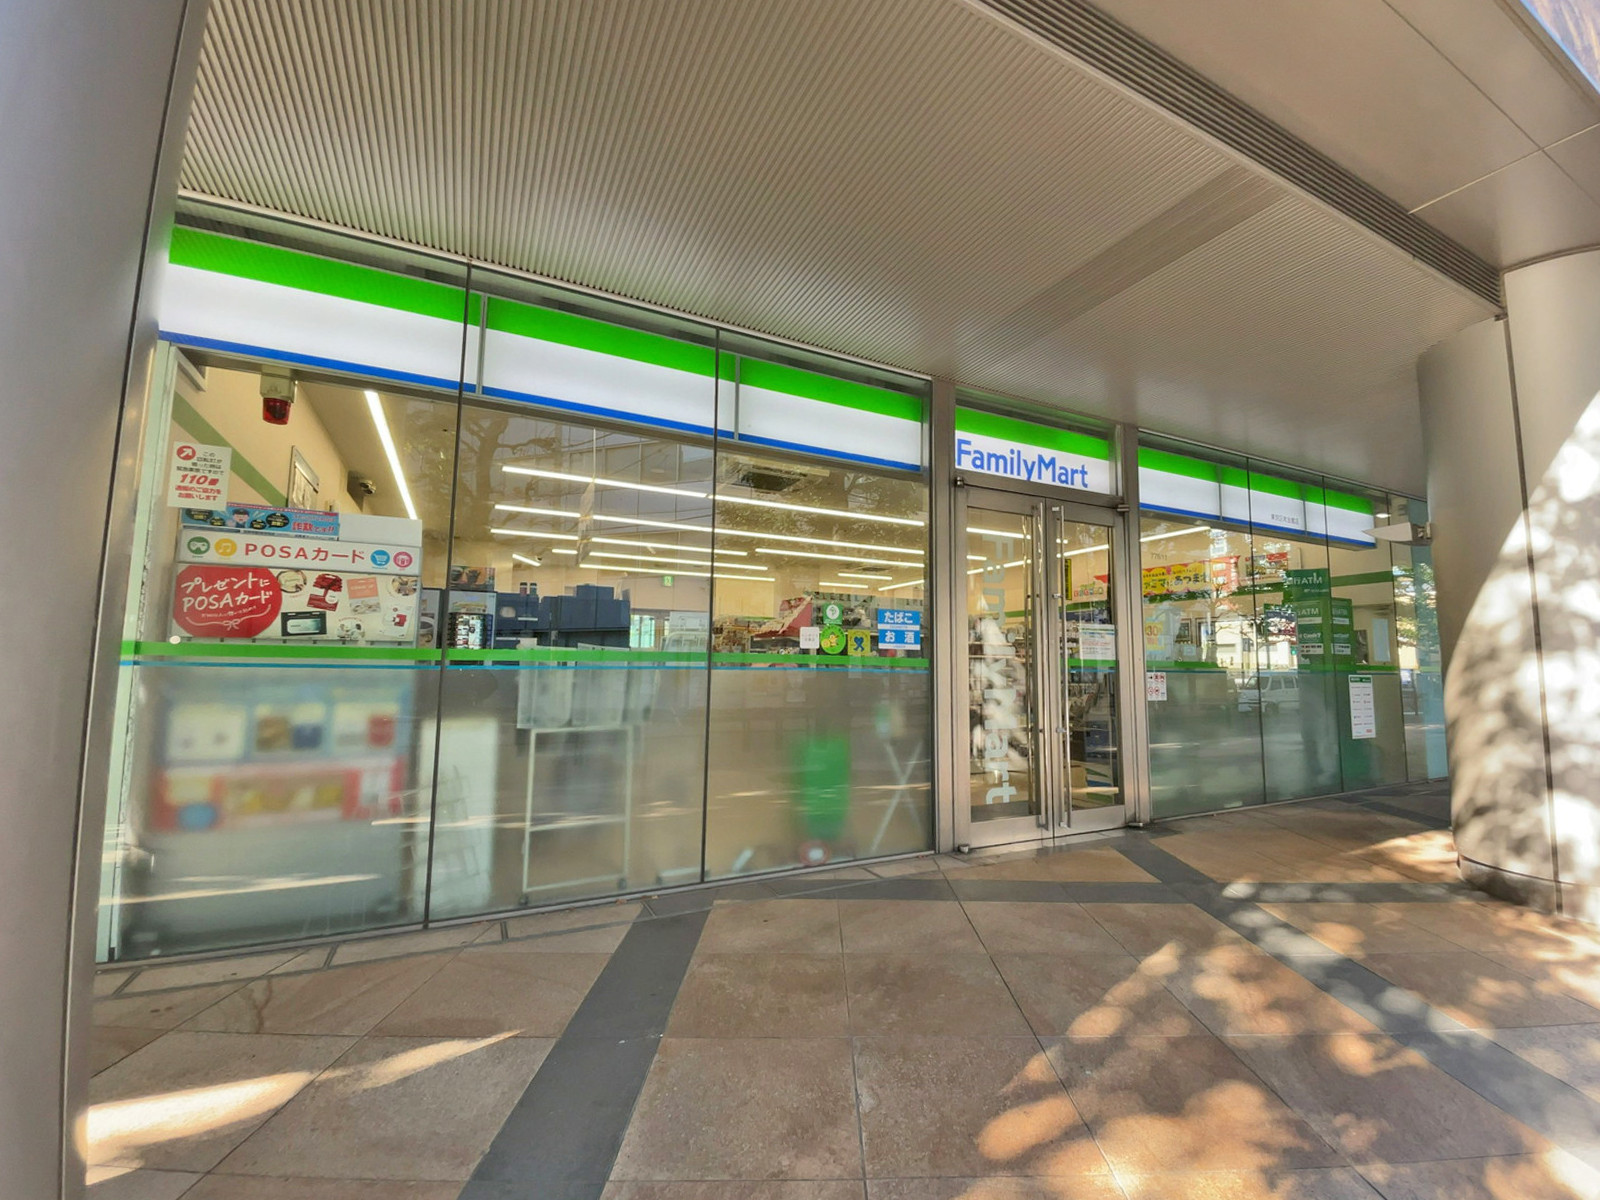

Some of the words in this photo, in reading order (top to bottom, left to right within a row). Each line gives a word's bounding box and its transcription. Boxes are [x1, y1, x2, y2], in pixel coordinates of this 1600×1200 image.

[957, 438, 1088, 488] FamilyMart
[244, 542, 365, 564] POSAカード
[181, 572, 271, 594] プレゼントに
[183, 590, 273, 613] POSAカード
[884, 611, 913, 624] たばこ
